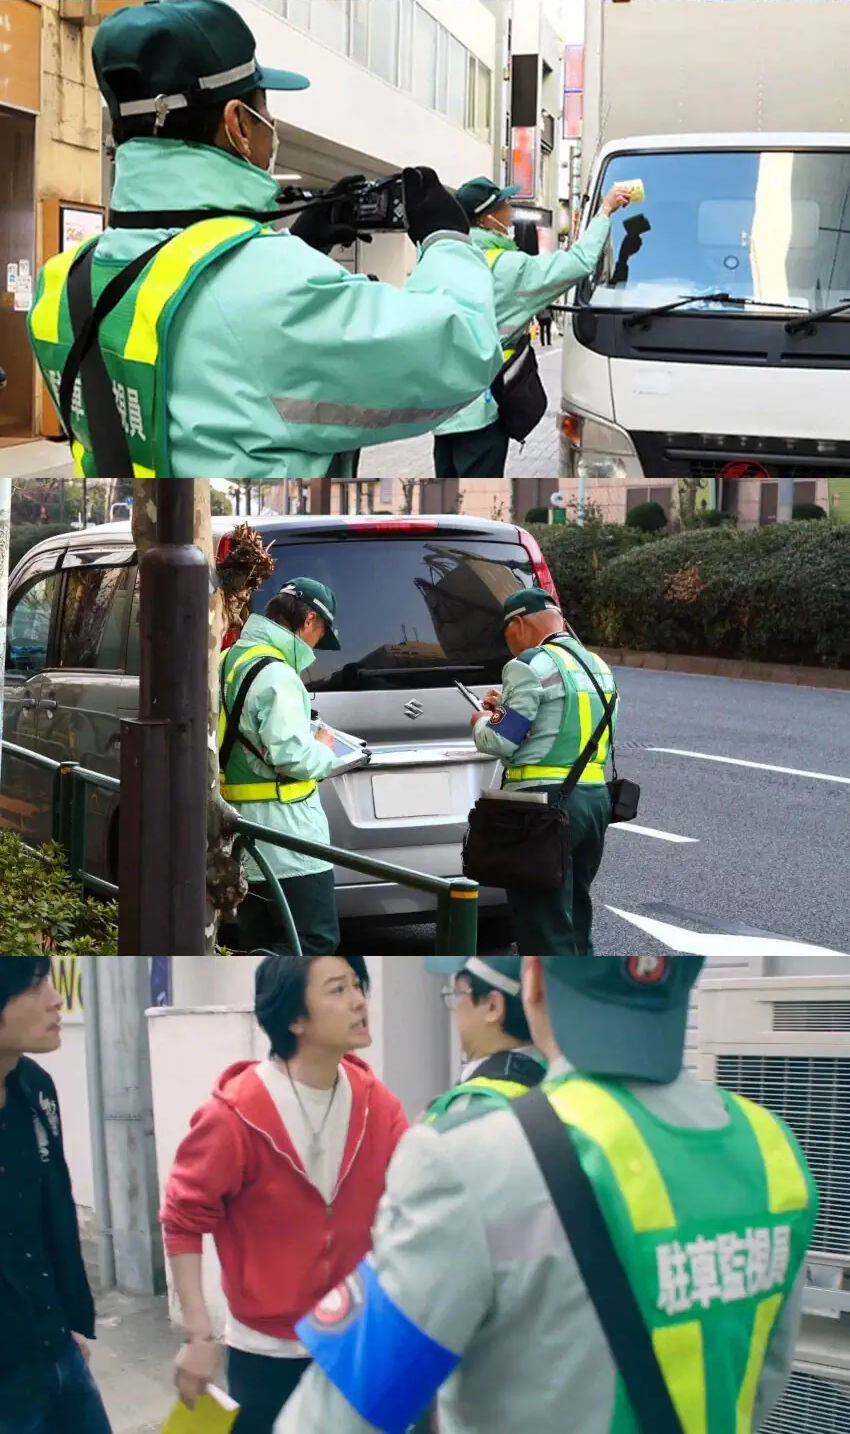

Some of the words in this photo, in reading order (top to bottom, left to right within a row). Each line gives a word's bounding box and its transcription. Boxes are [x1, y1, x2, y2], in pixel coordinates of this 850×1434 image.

[655, 1224, 792, 1316] 駐車監視員
